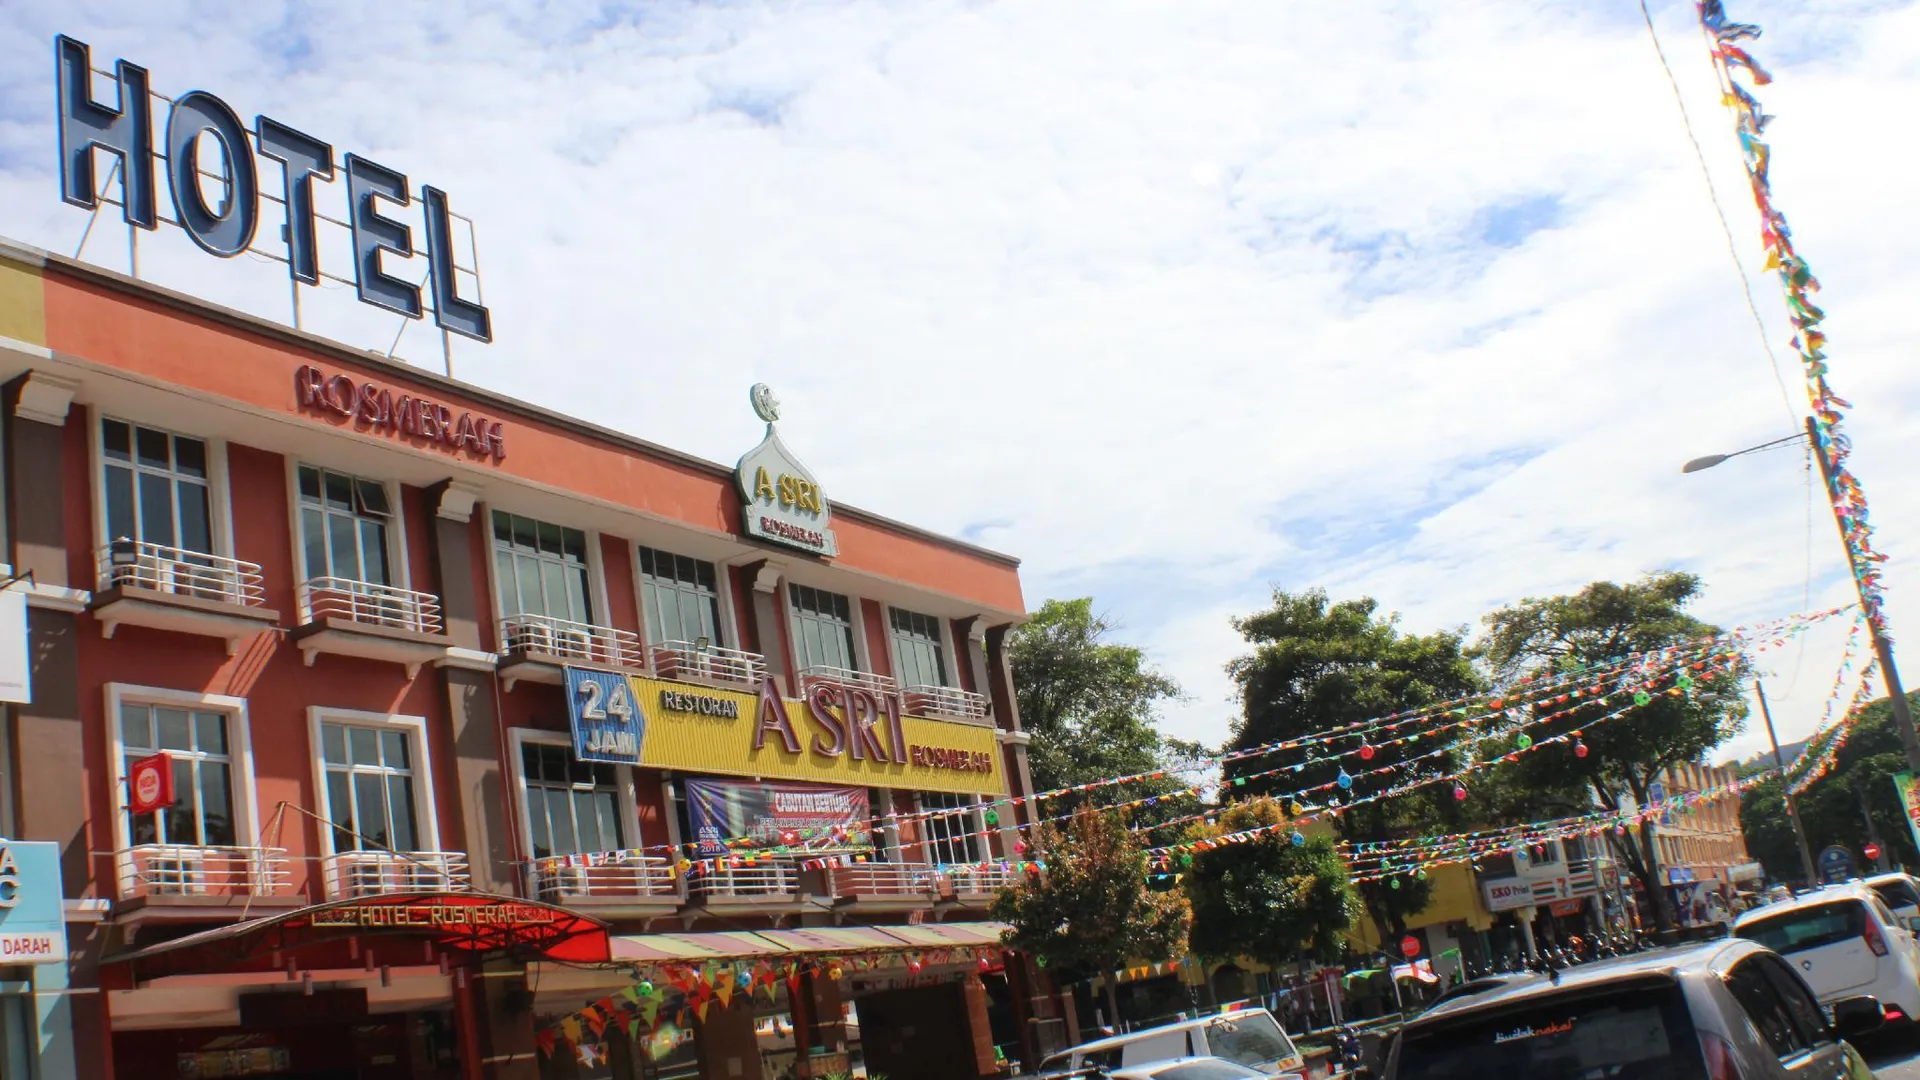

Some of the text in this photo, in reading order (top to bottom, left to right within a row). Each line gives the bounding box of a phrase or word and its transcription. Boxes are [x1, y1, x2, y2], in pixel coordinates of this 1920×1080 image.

[56, 33, 492, 343] HOTEL
[296, 365, 505, 460] ROSMERAH
[578, 679, 632, 722] 24
[660, 690, 739, 720] RESTORAN
[910, 744, 993, 774] ROSMERAH
[775, 792, 851, 814] CABUTAN BERTUAH
[1491, 886, 1511, 899] EKO
[360, 904, 517, 926] HOTEL ROSMERAH
[3, 938, 51, 955] DARAH
